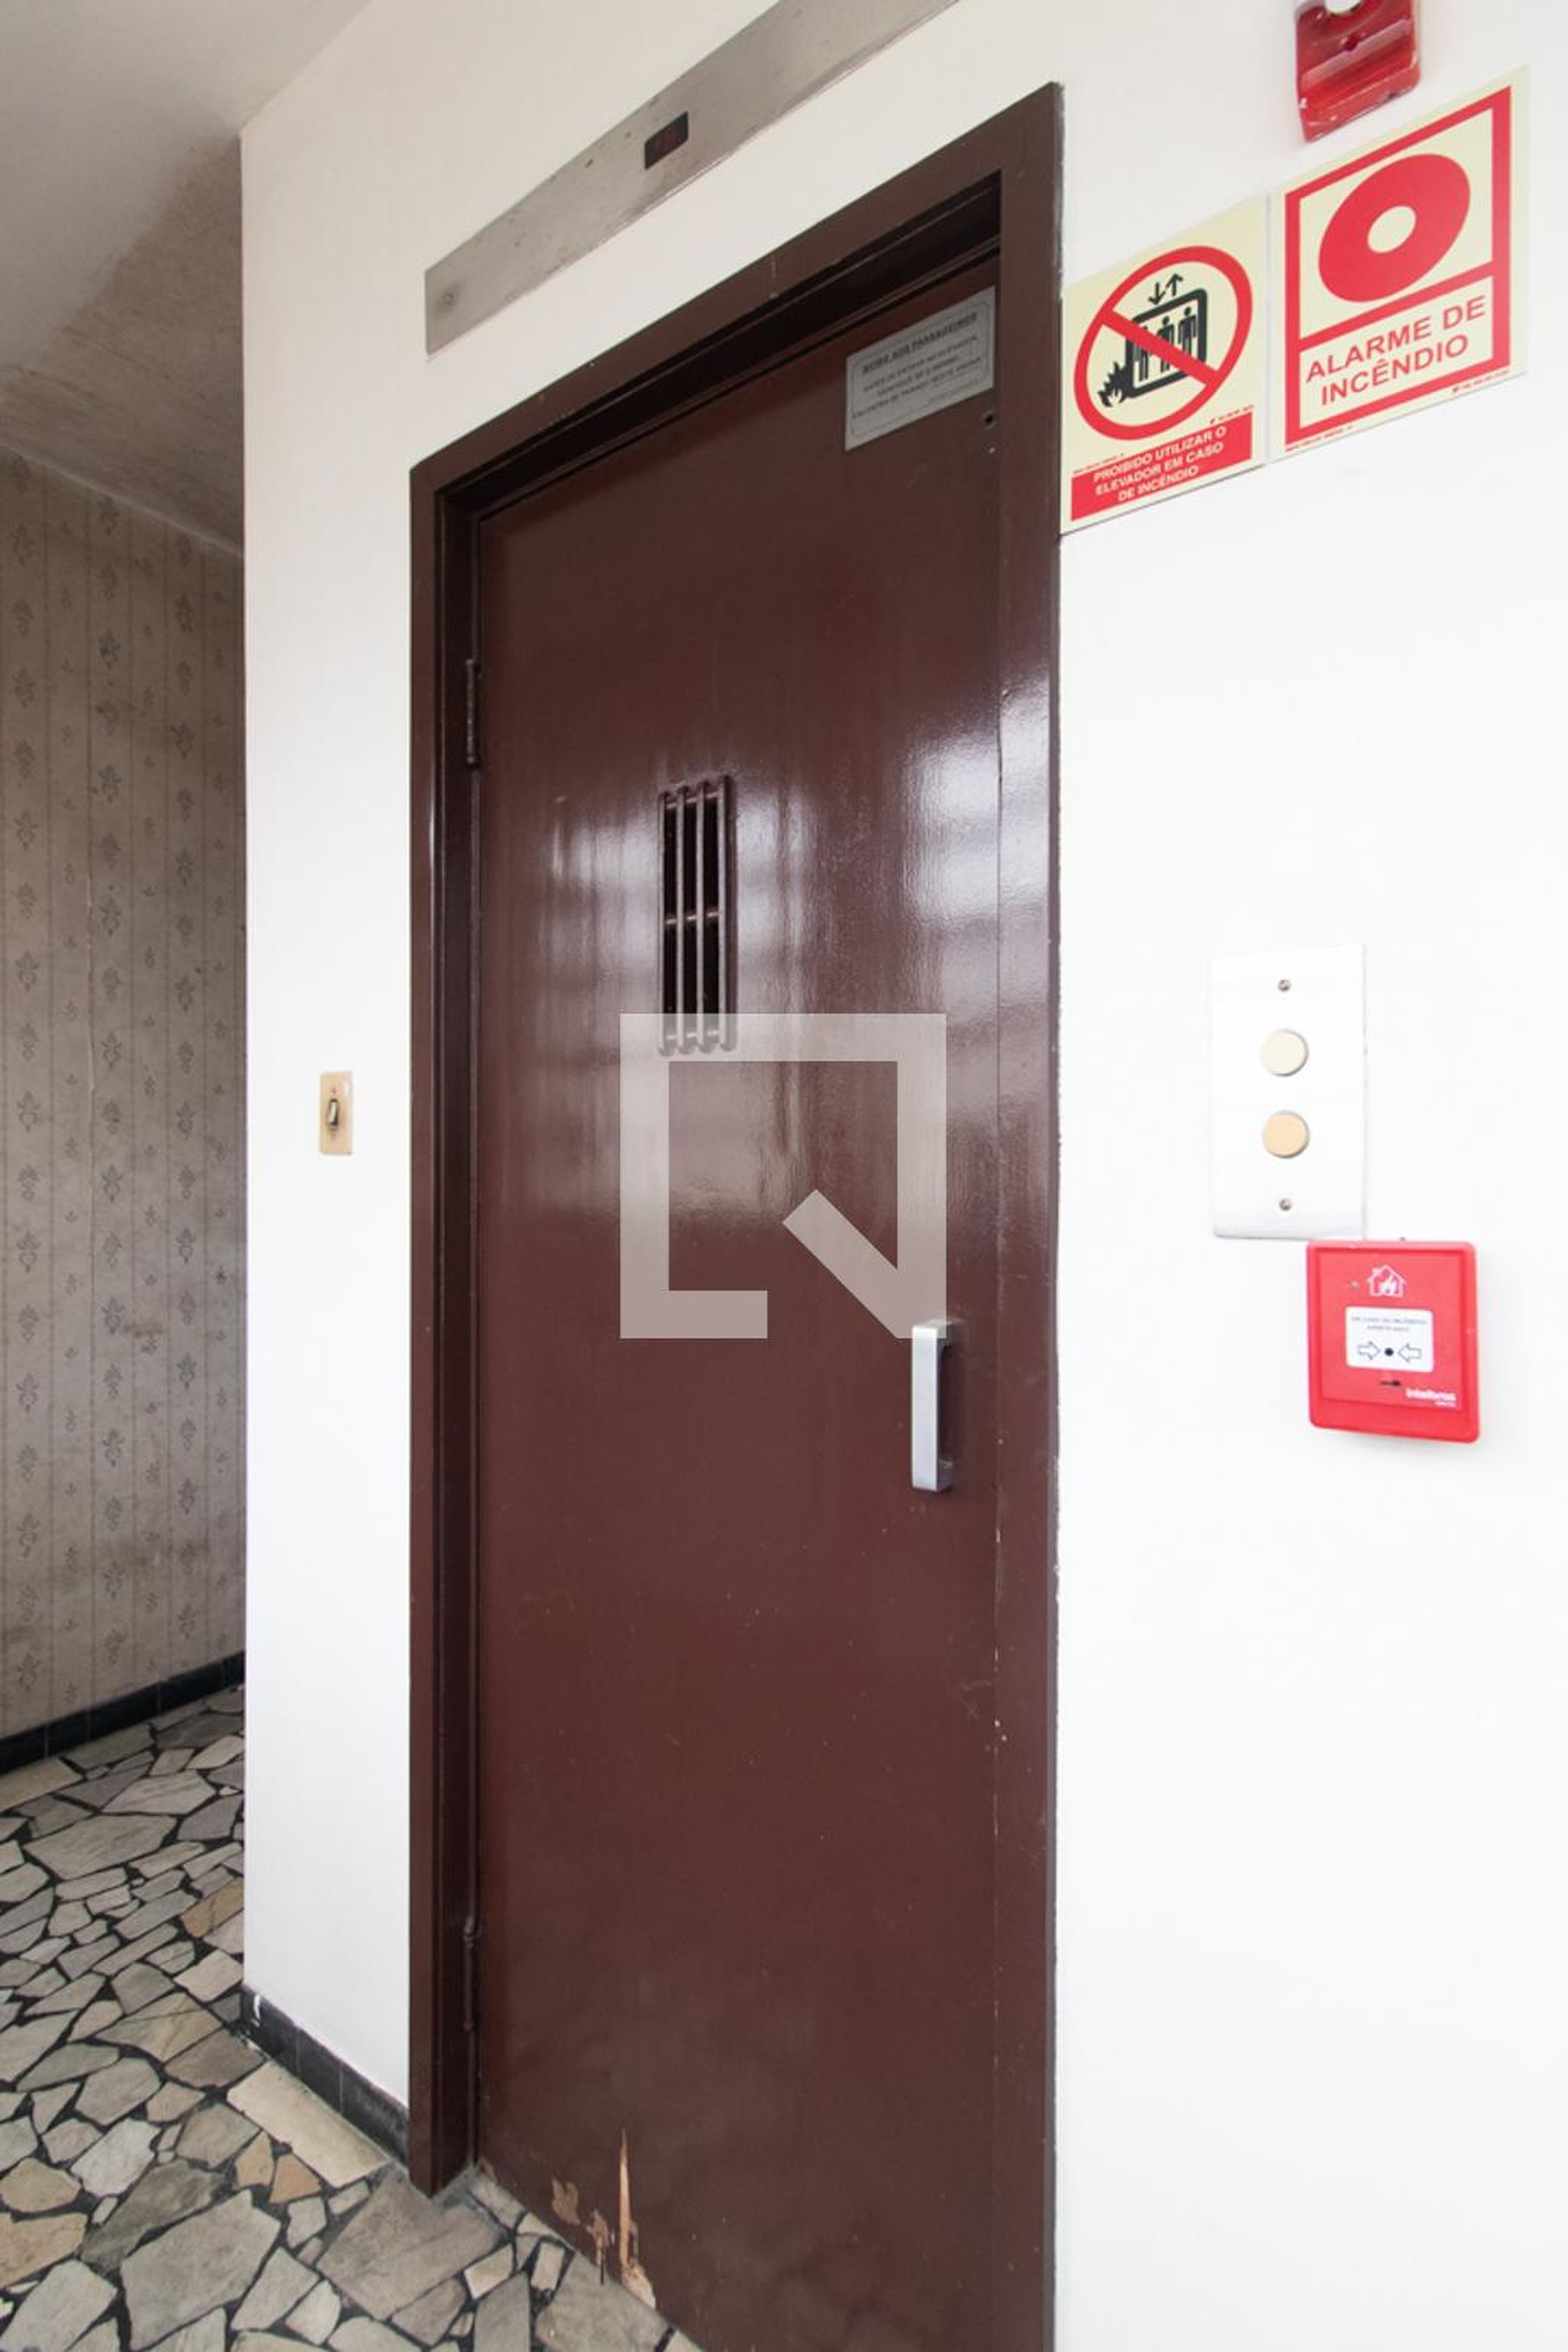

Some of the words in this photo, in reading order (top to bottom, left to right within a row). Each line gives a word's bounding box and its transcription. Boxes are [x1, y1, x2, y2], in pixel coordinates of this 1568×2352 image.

[1306, 316, 1432, 383] ALARME
[1443, 295, 1486, 330] DE
[1322, 334, 1468, 405] INCÊNDIO
[1094, 453, 1153, 482] PROIBIDO
[1155, 431, 1213, 460] UTILIZAR
[1216, 426, 1227, 438] O
[1096, 464, 1161, 495] ELEVADOR
[1165, 457, 1183, 471] EM
[1186, 441, 1223, 463] CASO
[1119, 488, 1135, 501] DE
[1138, 466, 1198, 494] INCÊNDIO
